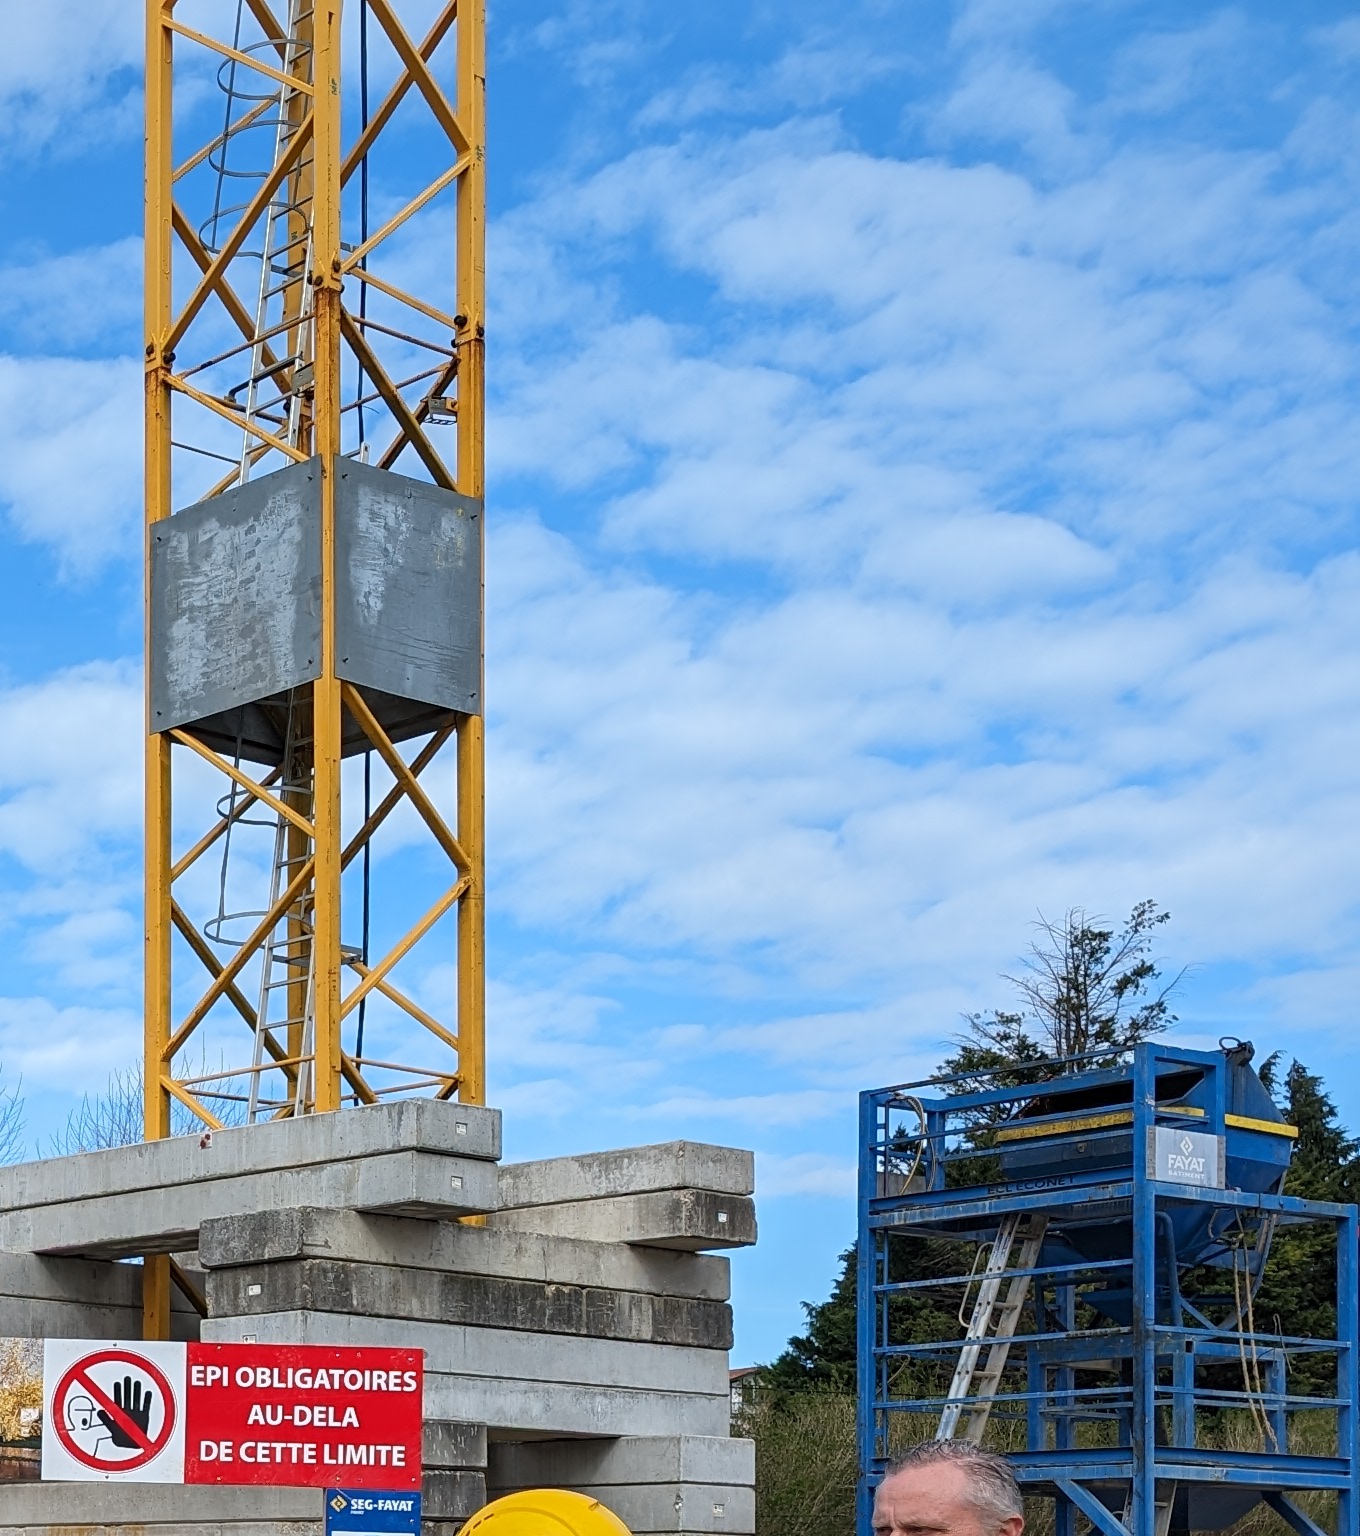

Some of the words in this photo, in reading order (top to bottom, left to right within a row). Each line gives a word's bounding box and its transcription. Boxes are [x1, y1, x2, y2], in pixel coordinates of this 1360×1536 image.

[1168, 1154, 1206, 1171] FAYAT
[191, 1366, 229, 1387] EPI
[235, 1366, 418, 1392] OBLIGATOIRES
[247, 1404, 360, 1428] AU-DELA
[199, 1440, 233, 1462] DE
[239, 1441, 317, 1464] CETTE
[323, 1443, 406, 1467] LIMITE
[350, 1499, 414, 1512] SEG-FAYAT
